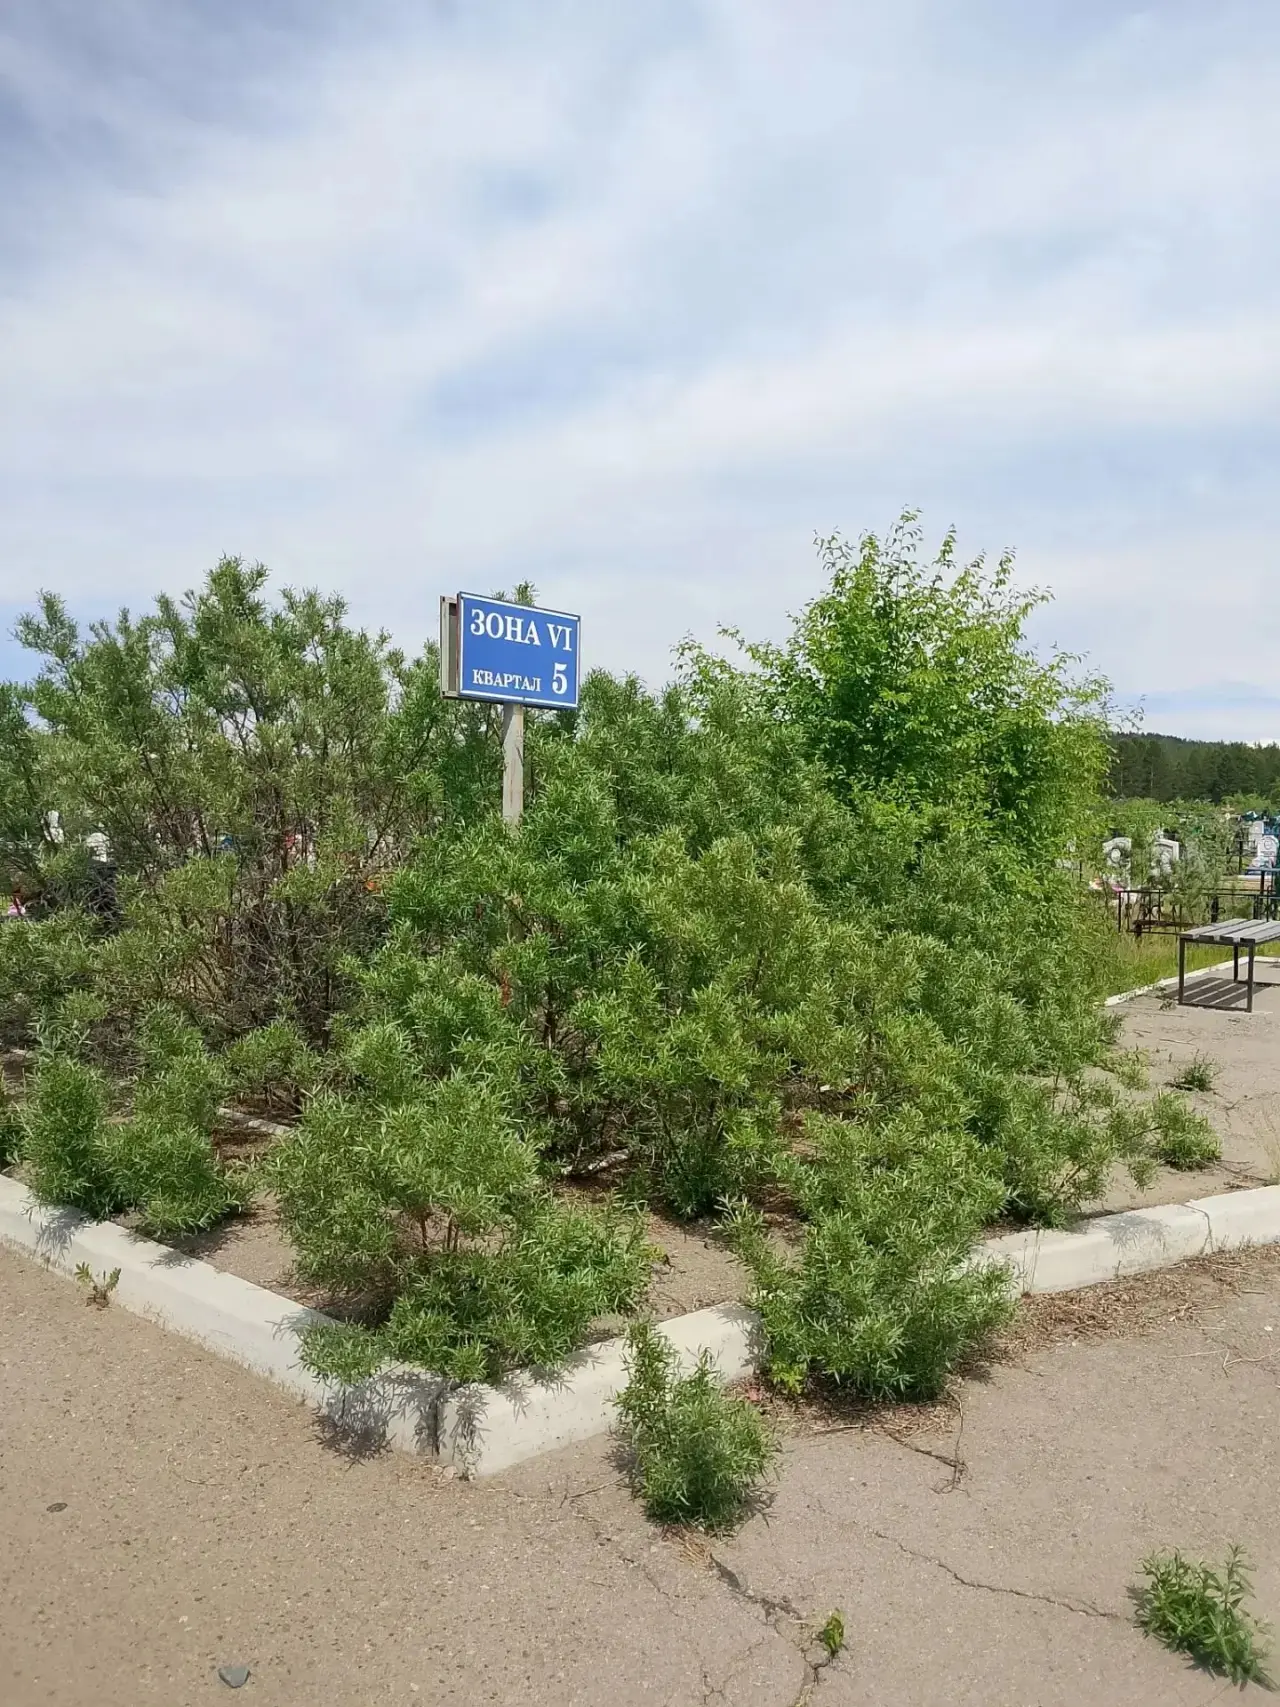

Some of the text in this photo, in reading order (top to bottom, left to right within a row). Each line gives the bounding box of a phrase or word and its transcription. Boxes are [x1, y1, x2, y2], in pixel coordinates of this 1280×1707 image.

[470, 609, 572, 651] ЗОНА VI
[472, 662, 567, 694] КВАРТАЛ 5
